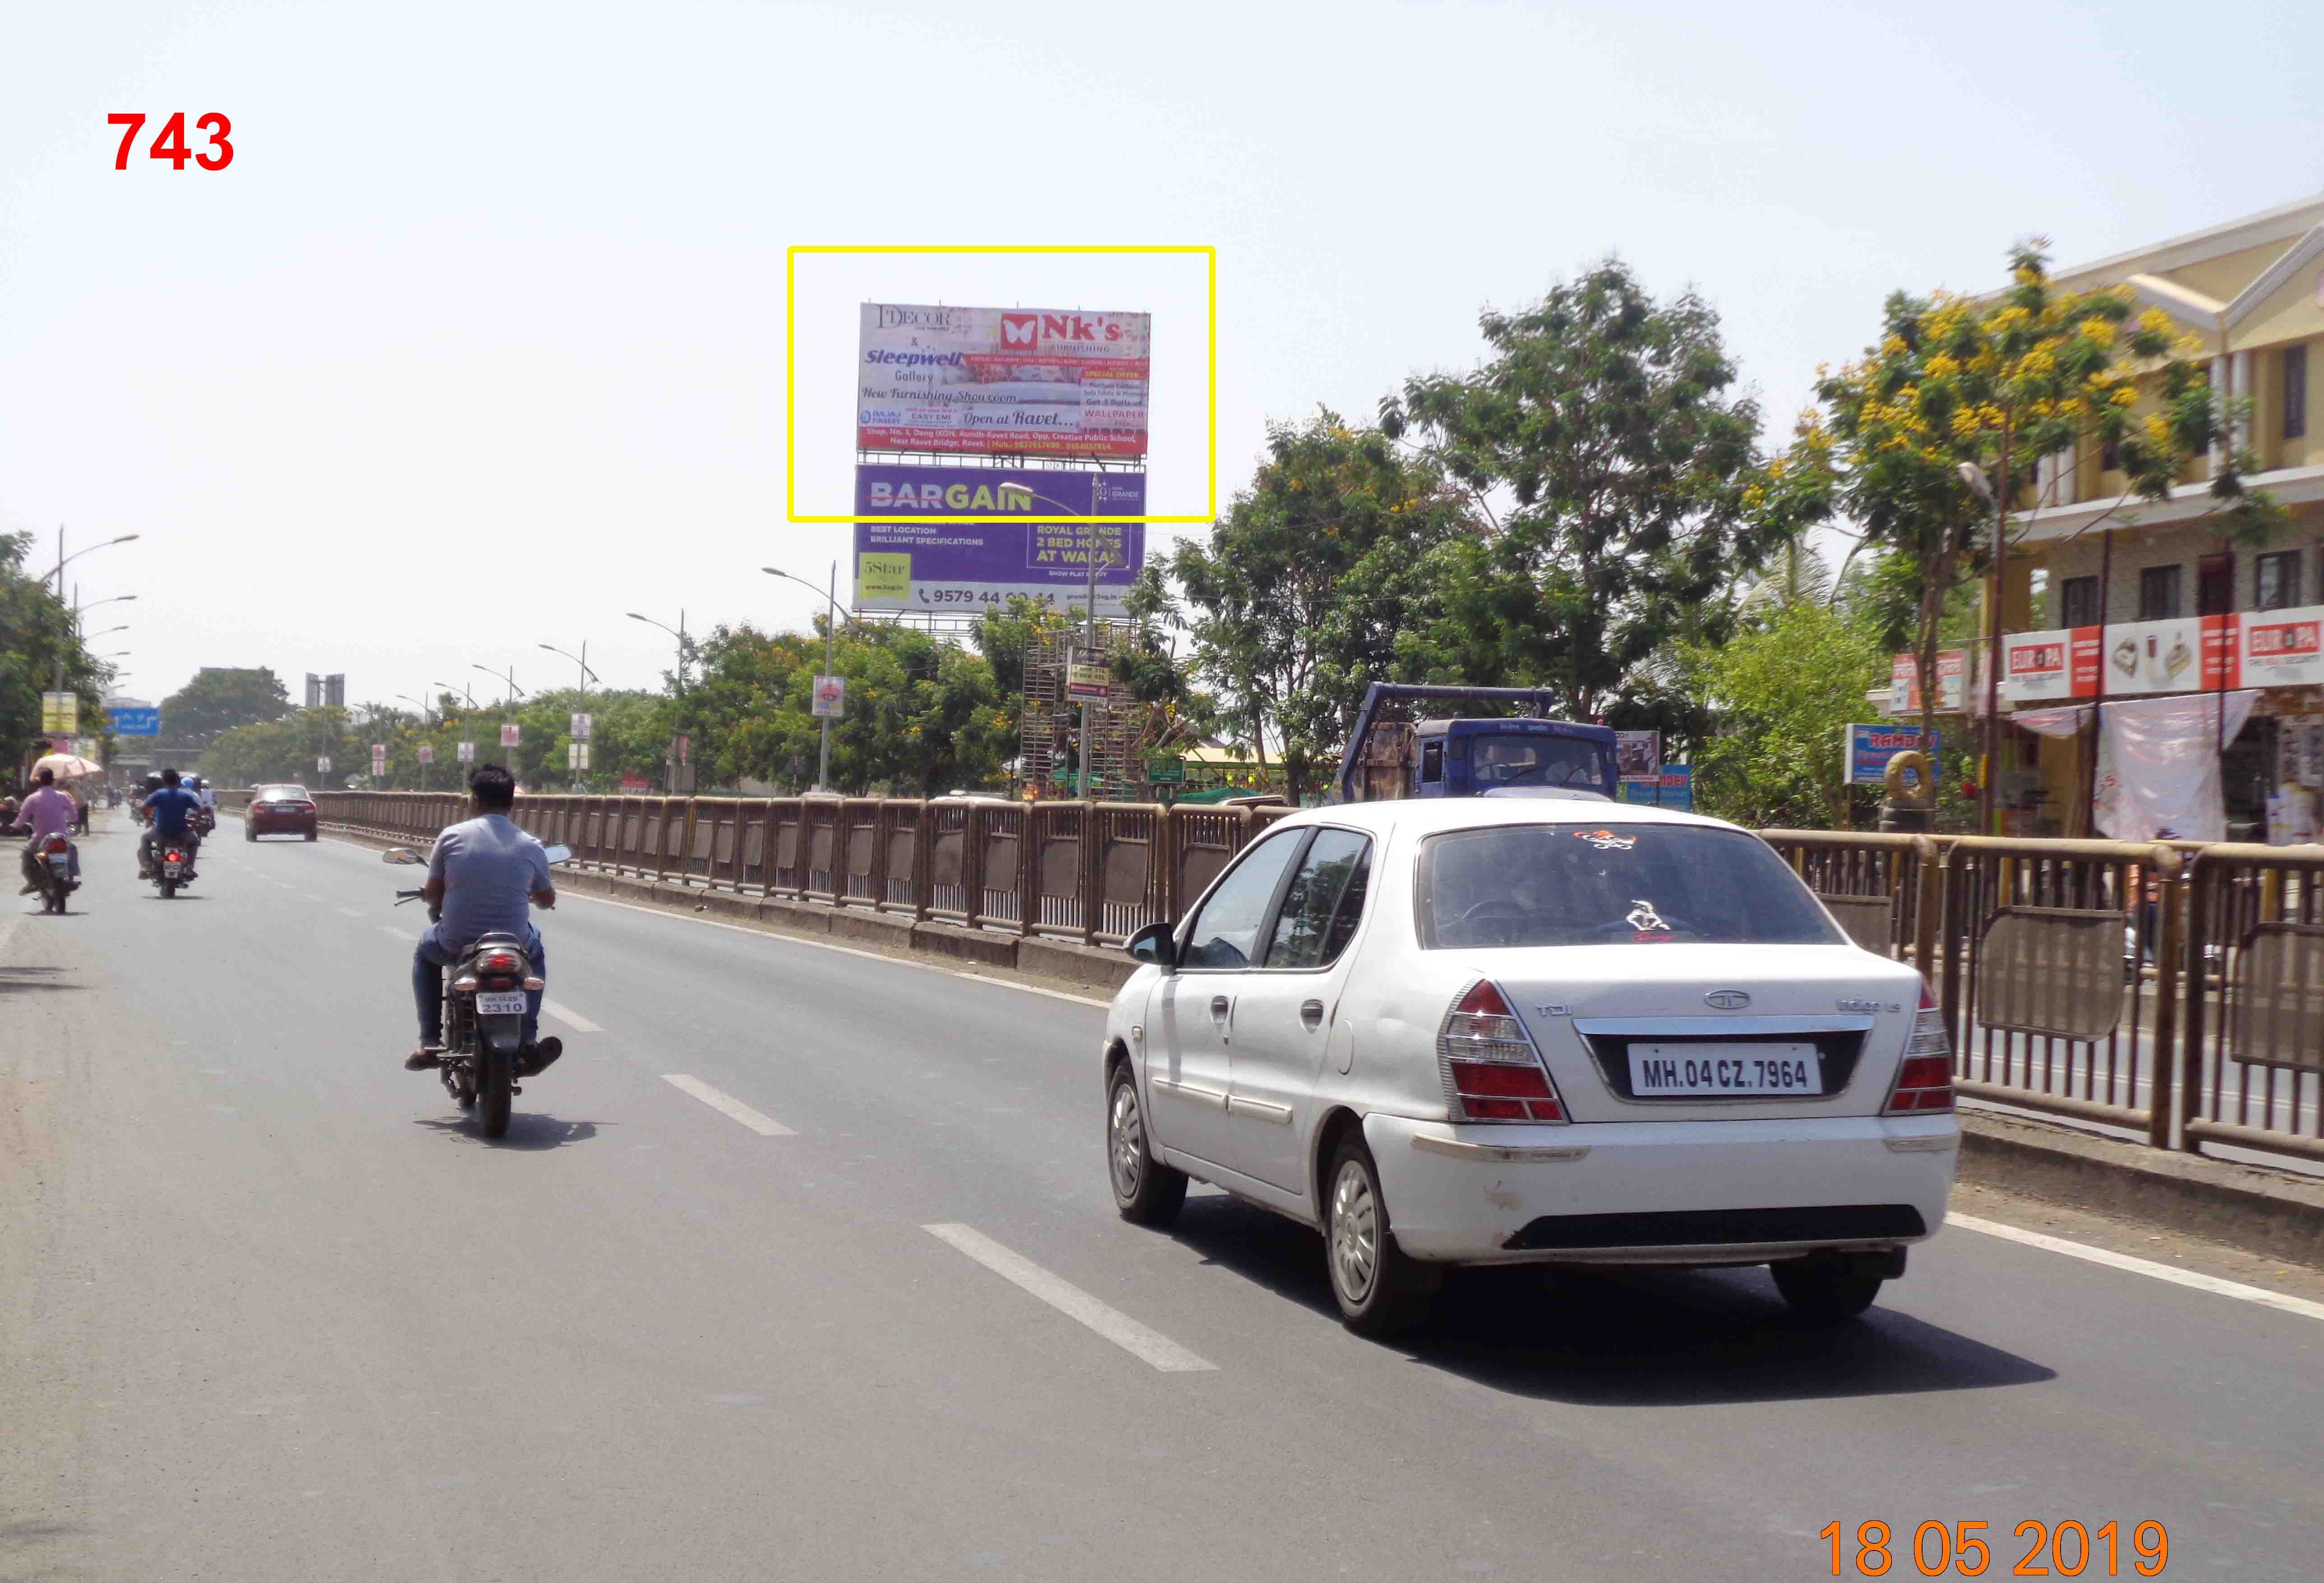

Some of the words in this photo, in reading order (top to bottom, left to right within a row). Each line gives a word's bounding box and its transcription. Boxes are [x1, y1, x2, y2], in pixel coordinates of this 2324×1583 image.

[1042, 314, 1123, 341] Nk's
[911, 337, 918, 346] &
[895, 370, 933, 383] Gallery
[861, 387, 887, 399] New
[890, 388, 954, 403] Furnishing
[963, 413, 991, 426] Open
[996, 413, 1009, 424] at
[1084, 410, 1144, 419] WALLPAPER
[871, 482, 1031, 511] BARGAIN
[871, 525, 892, 533] BEST
[894, 526, 936, 535] LOCATION
[1037, 525, 1073, 535] ROYAL
[1075, 527, 1122, 536] GRNDE
[871, 535, 913, 544] BRILLIANT
[916, 537, 984, 546] SPECIFICATIONS
[1037, 537, 1044, 547] 2
[1047, 537, 1073, 548] BED
[1037, 549, 1057, 562] AT
[863, 561, 905, 574] 5Star
[933, 590, 973, 603] 9579
[978, 591, 1001, 603] 44
[483, 1003, 522, 1012] 2310
